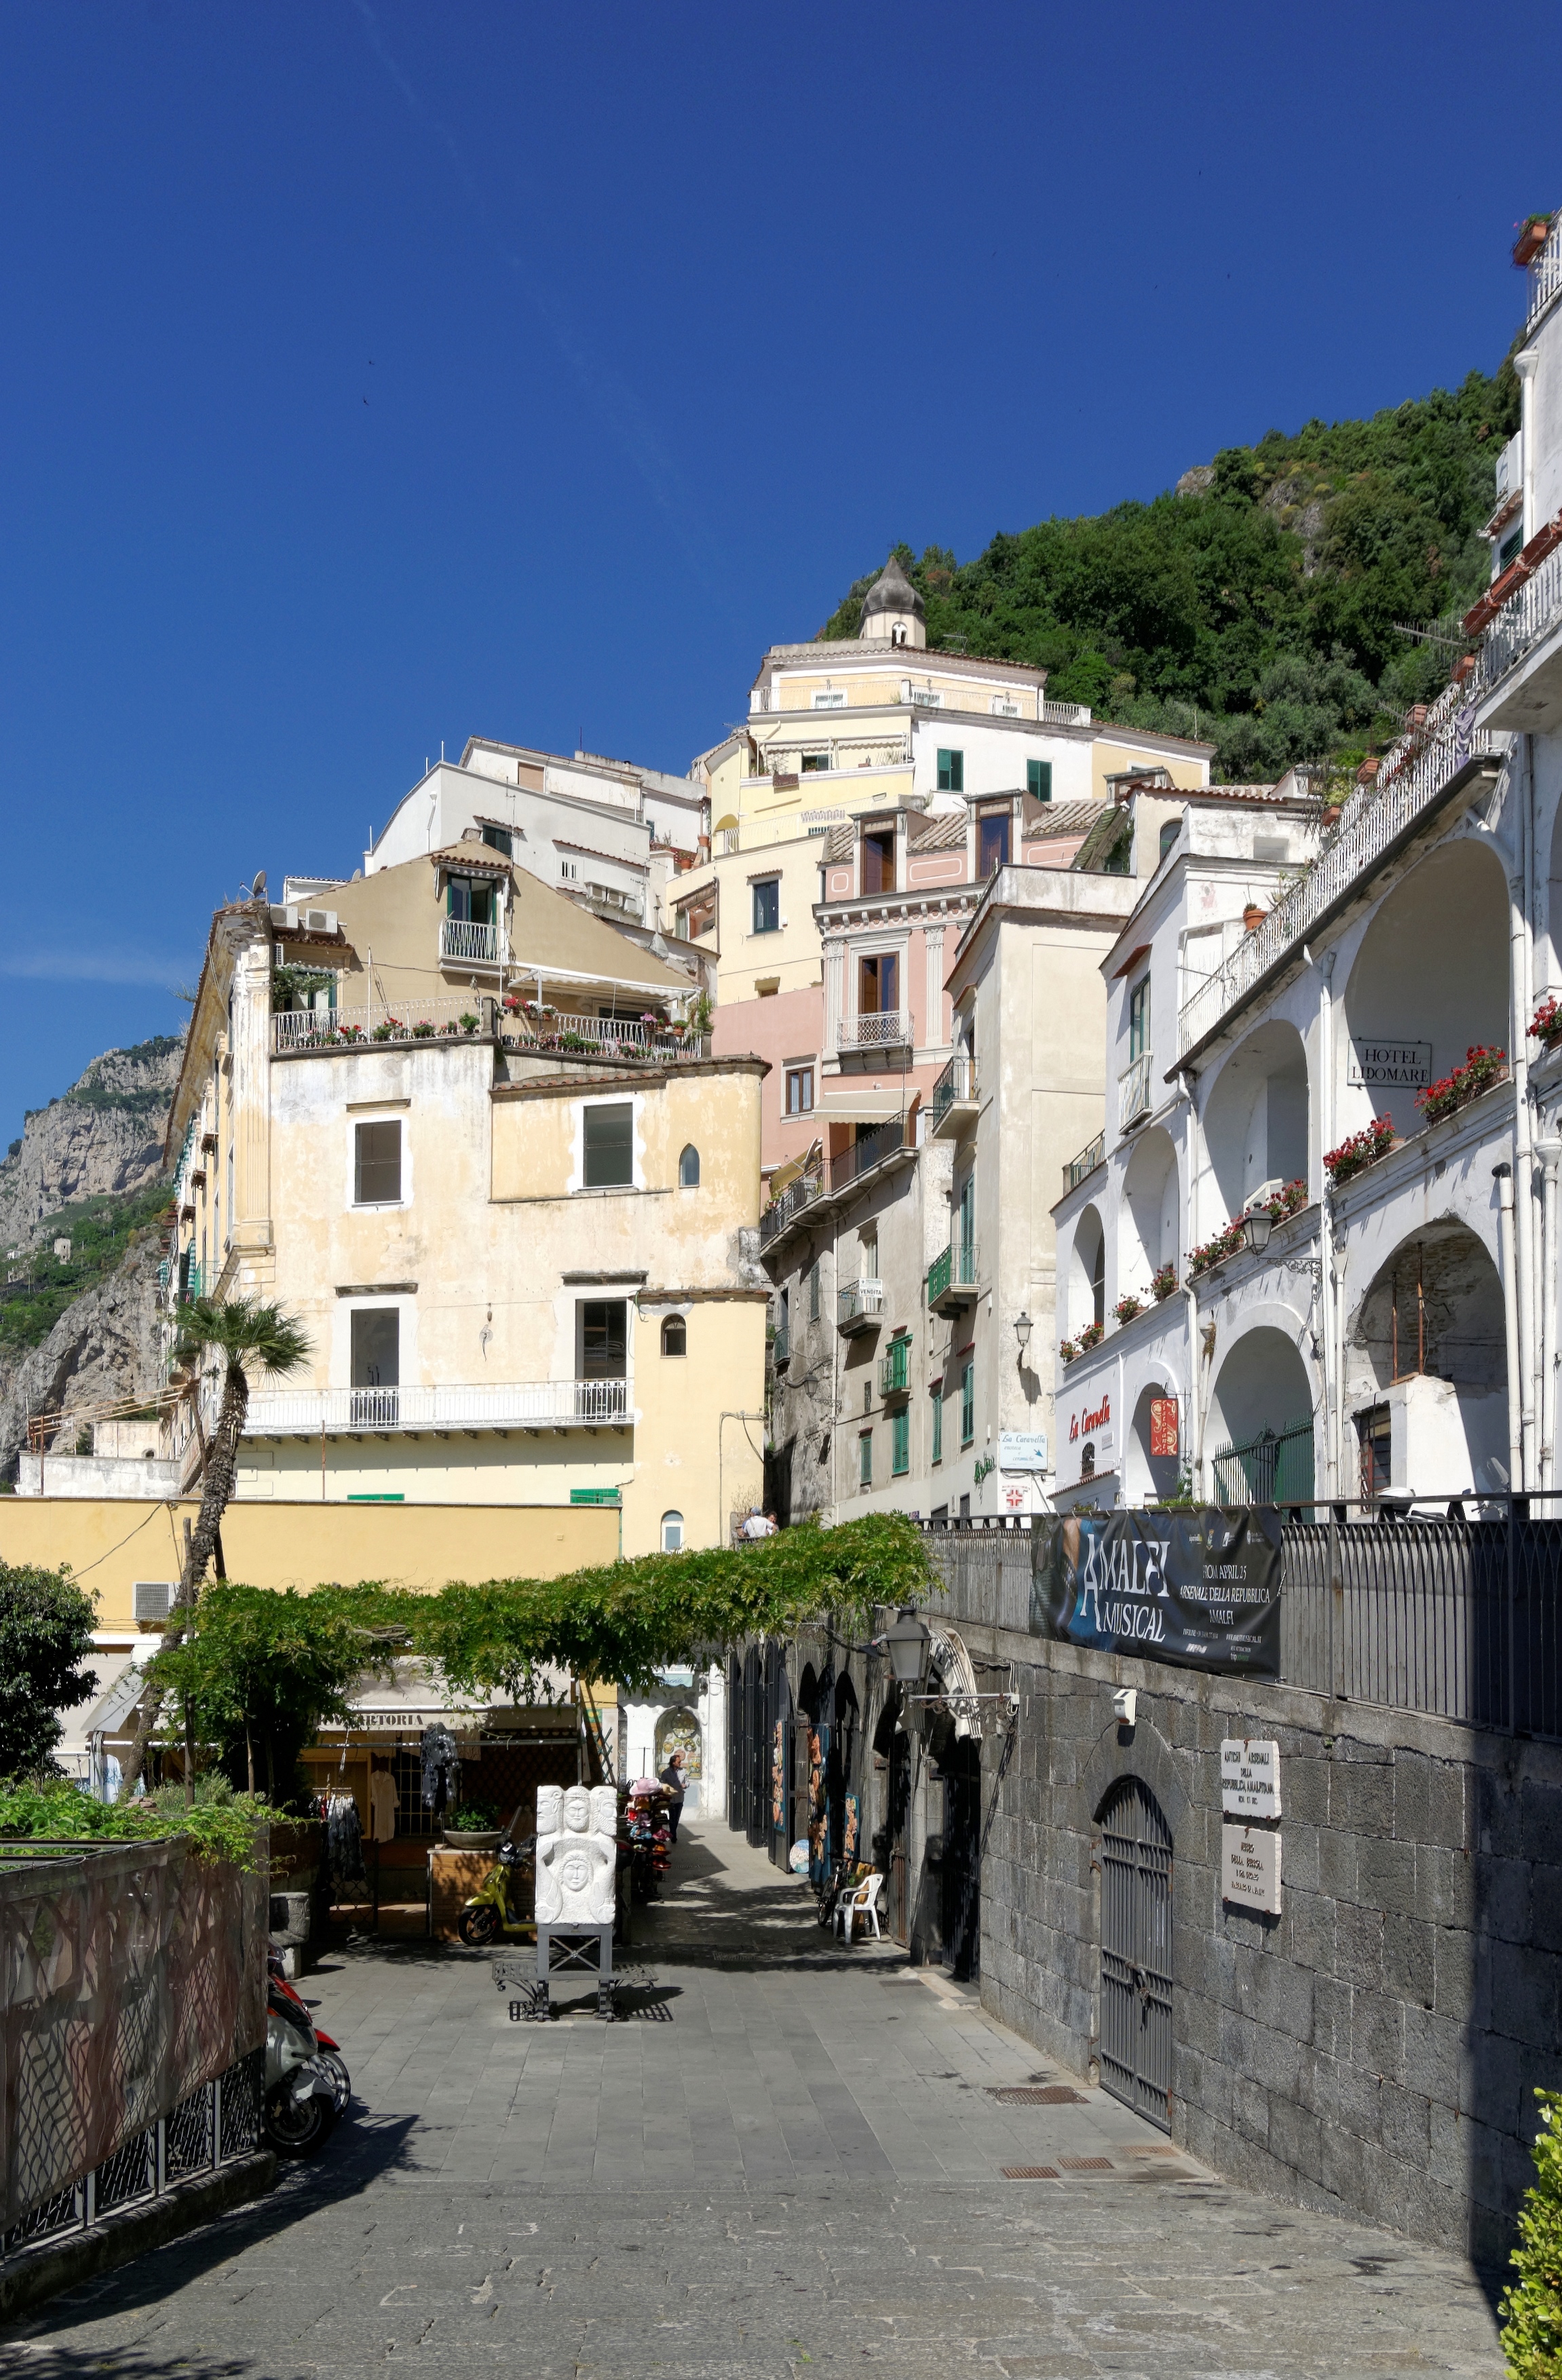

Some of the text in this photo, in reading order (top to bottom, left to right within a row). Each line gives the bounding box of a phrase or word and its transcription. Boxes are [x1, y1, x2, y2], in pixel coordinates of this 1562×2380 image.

[1365, 1048, 1421, 1064] HOTEL
[1352, 1066, 1428, 1082] LIDOMARE
[1069, 1394, 1111, 1441] La Caravella
[1002, 1434, 1046, 1443] La Caravella
[1202, 1565, 1247, 1581] FROM APRIL 25
[1080, 1533, 1171, 1632] AMALFI
[1179, 1584, 1270, 1603] ARSENALE DELLA REPUBBLICA
[1103, 1601, 1166, 1643] MUSICAL
[1209, 1609, 1234, 1626] AMALFI
[351, 1714, 423, 1725] ARTORIA
